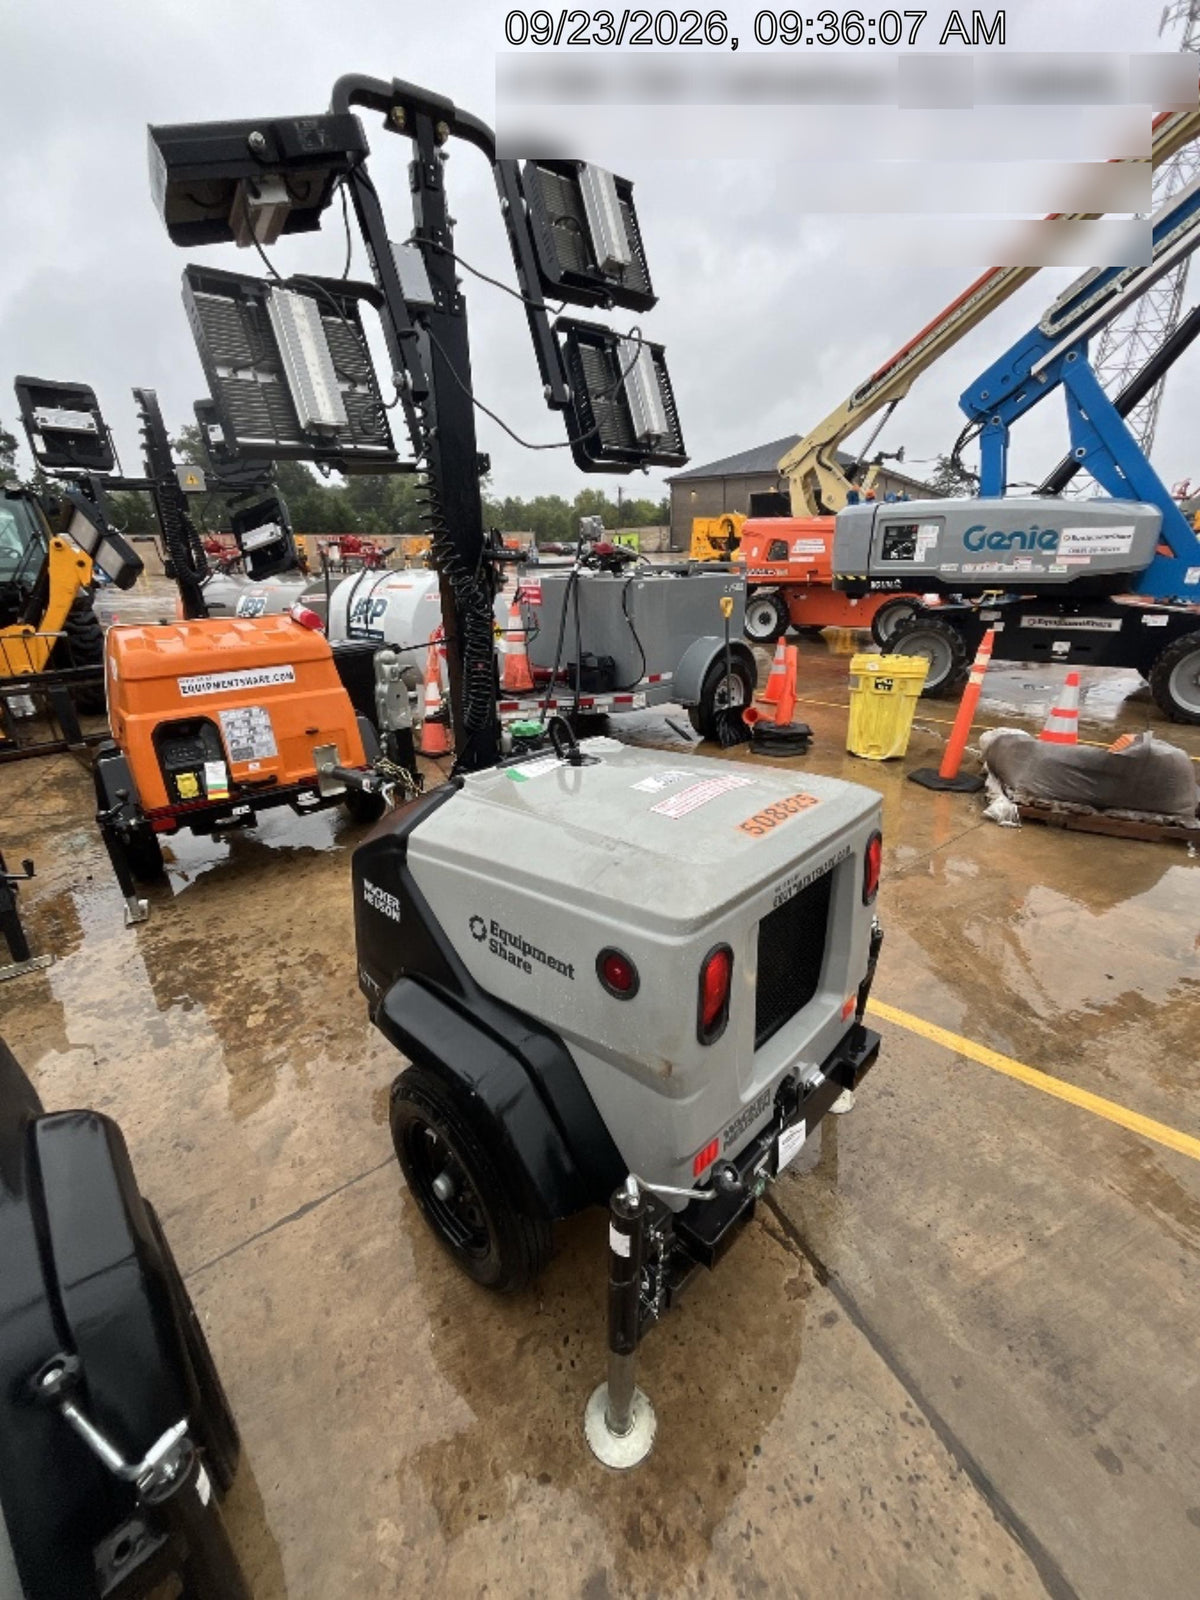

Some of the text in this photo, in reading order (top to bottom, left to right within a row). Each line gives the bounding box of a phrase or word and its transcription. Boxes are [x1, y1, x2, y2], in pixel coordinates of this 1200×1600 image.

[963, 524, 1059, 551] Genie
[489, 938, 532, 975] Share
[490, 919, 575, 980] Equipment
